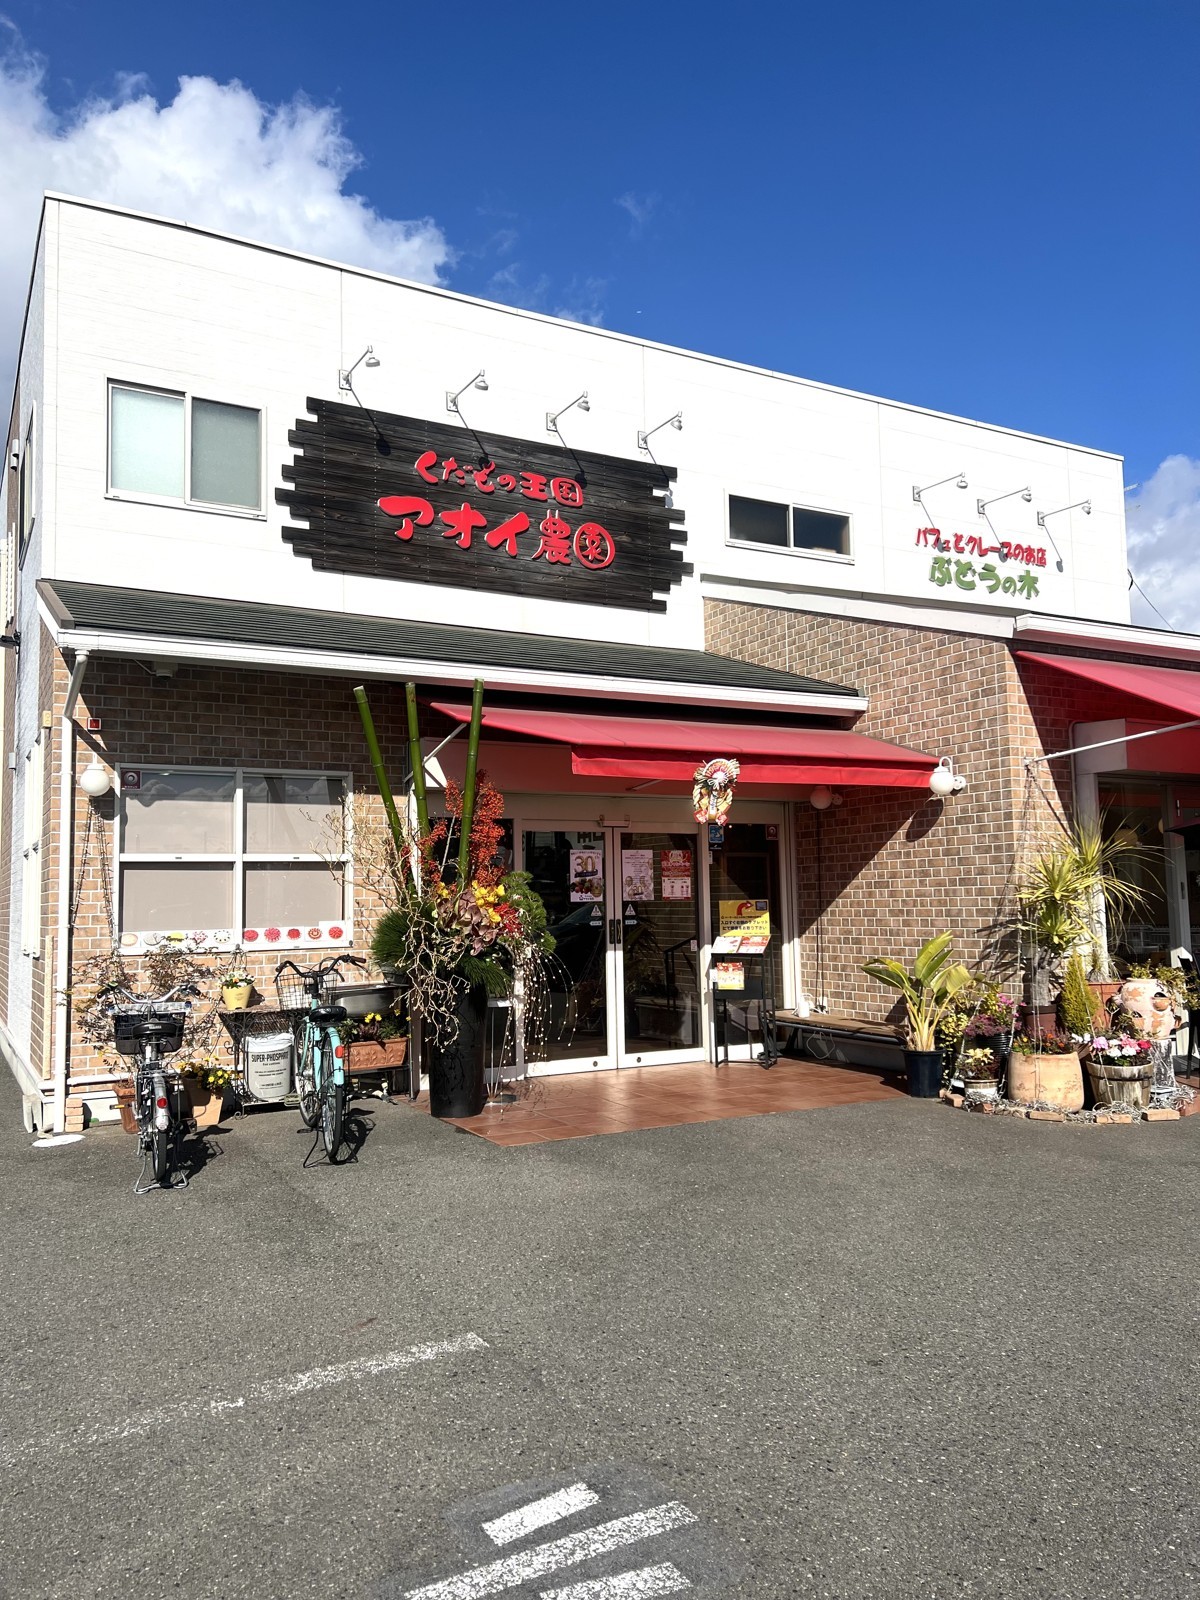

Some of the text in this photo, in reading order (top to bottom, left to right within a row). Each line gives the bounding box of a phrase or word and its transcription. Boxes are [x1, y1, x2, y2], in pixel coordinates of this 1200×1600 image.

[414, 450, 584, 507] くだもの王国
[377, 495, 616, 570] アオイ農園
[915, 527, 1047, 568] パフェとクレープのお店
[929, 556, 1040, 600] ぶどうの木
